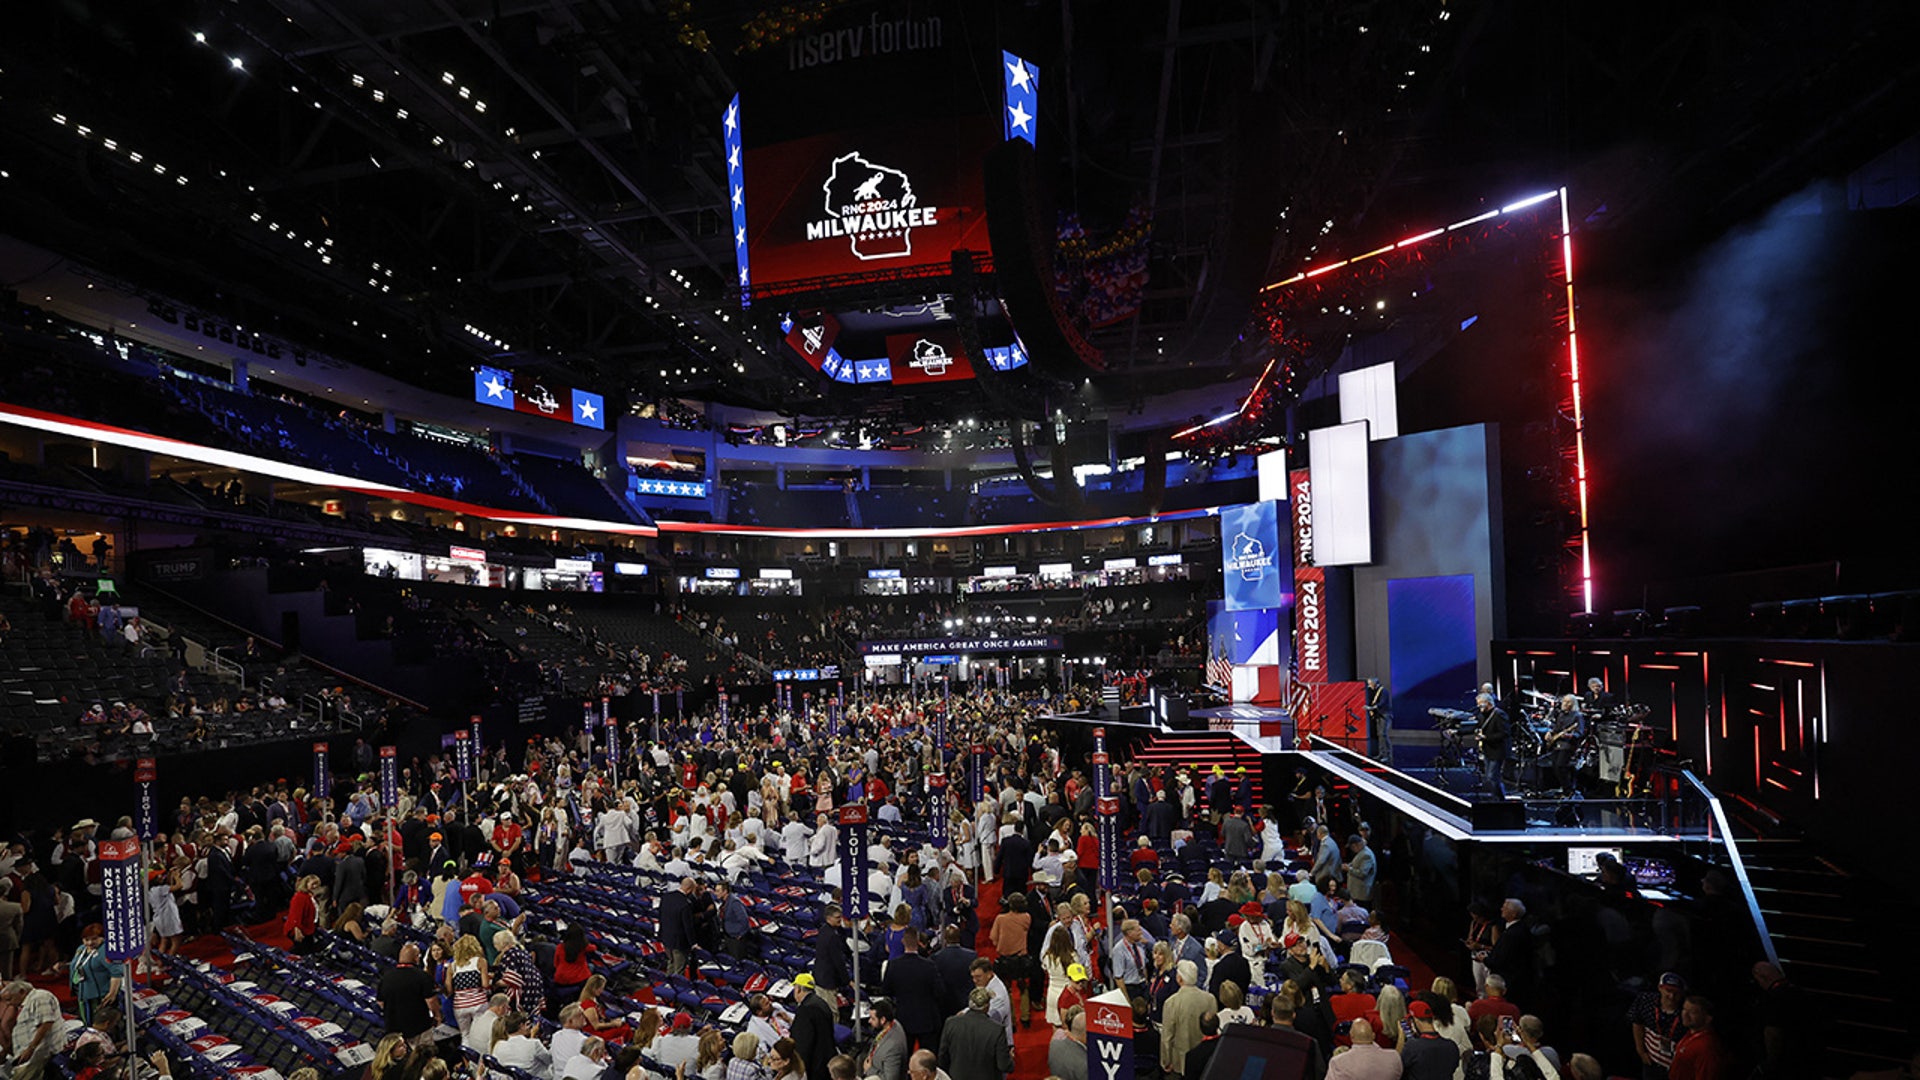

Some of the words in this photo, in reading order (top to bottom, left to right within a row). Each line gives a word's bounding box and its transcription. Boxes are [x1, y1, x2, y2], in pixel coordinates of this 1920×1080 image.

[868, 10, 943, 56] forum
[806, 207, 937, 240] MILWAUKEE
[155, 562, 197, 575] TRUMP
[872, 644, 899, 652] MAKE
[902, 643, 946, 651] AMERICA
[948, 641, 980, 649] GREAT
[982, 640, 1010, 648] ONCE
[1012, 639, 1048, 647] AGAIN!
[387, 758, 395, 803] MICHIGAN
[141, 782, 152, 838] VIRGINIA
[931, 795, 940, 838] OHIO
[848, 827, 860, 915] LOUISIANA
[1109, 815, 1118, 886] MISSOURI
[103, 867, 117, 951] NORTHERN
[114, 868, 123, 909] MARIANA
[125, 864, 137, 950] NORTHERN
